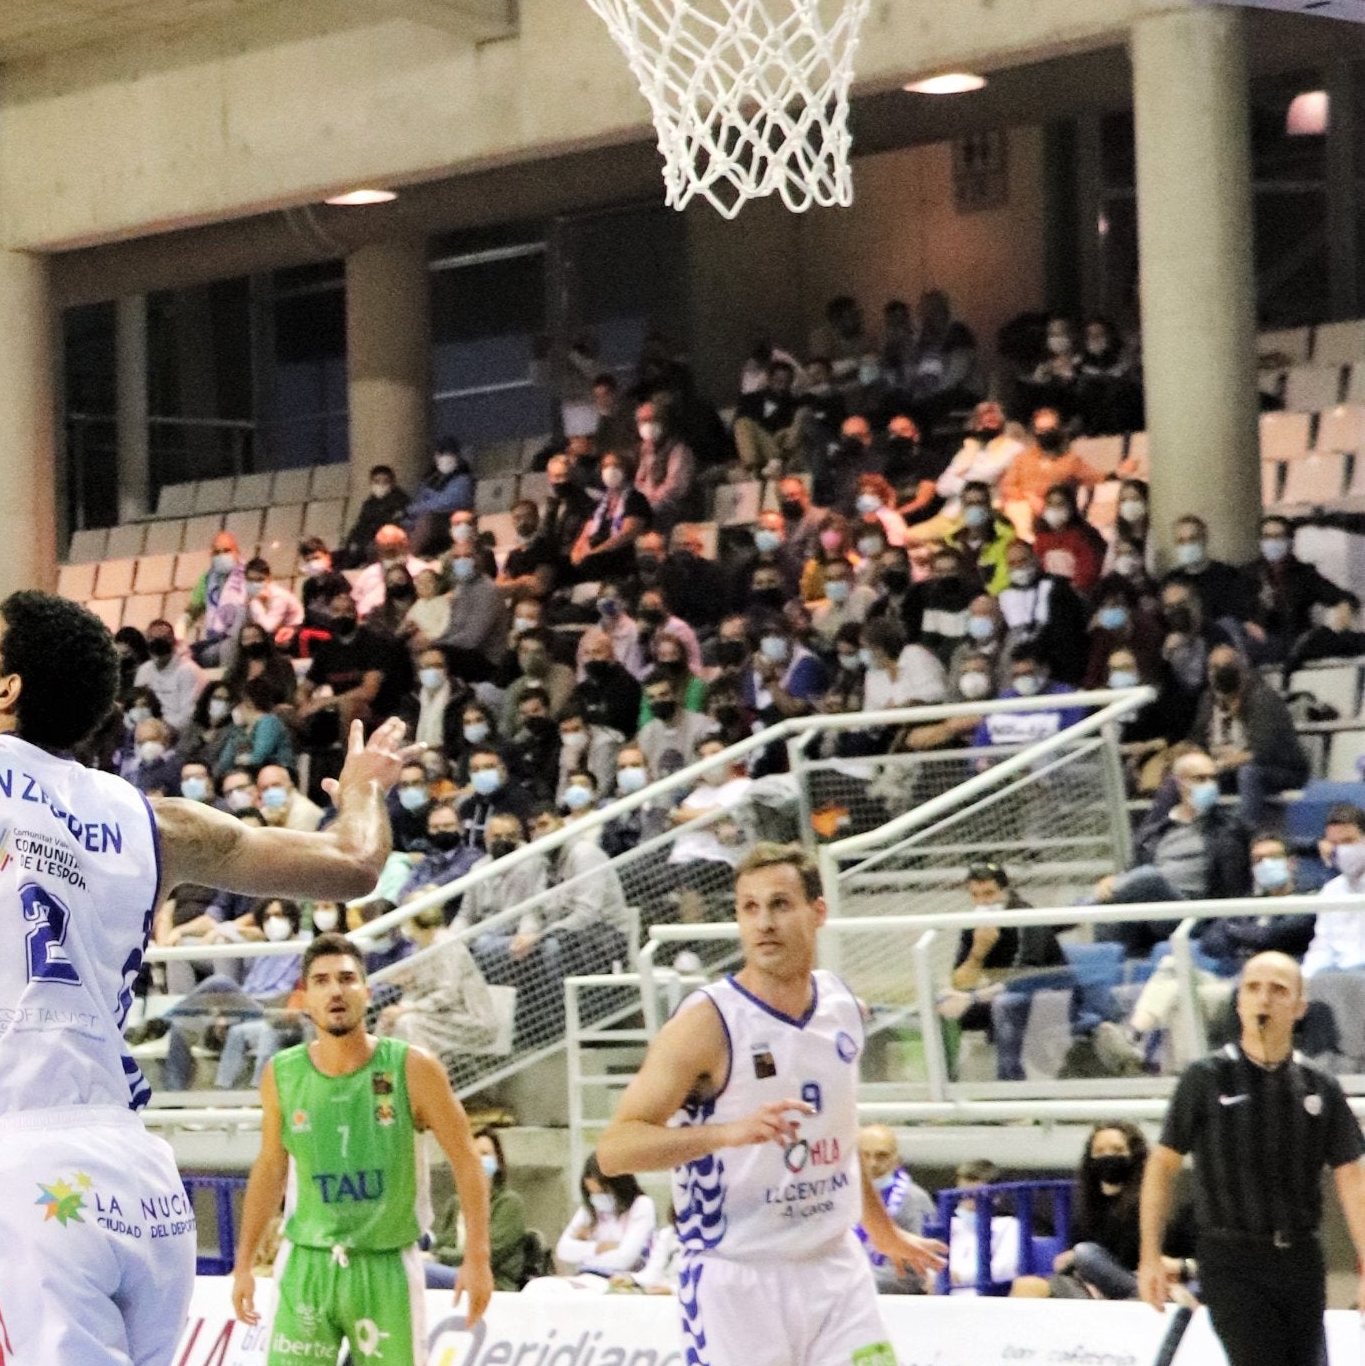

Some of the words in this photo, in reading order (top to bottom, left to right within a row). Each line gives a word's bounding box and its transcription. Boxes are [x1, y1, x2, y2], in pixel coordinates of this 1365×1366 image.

[13, 827, 54, 844] Comunitat
[20, 853, 33, 870] DE
[18, 881, 84, 987] 2
[800, 1081, 823, 1114] 9
[311, 1168, 385, 1204] TAU
[95, 1192, 123, 1217] LA
[96, 1216, 142, 1239] CIUDAD
[150, 1223, 170, 1239] DEL
